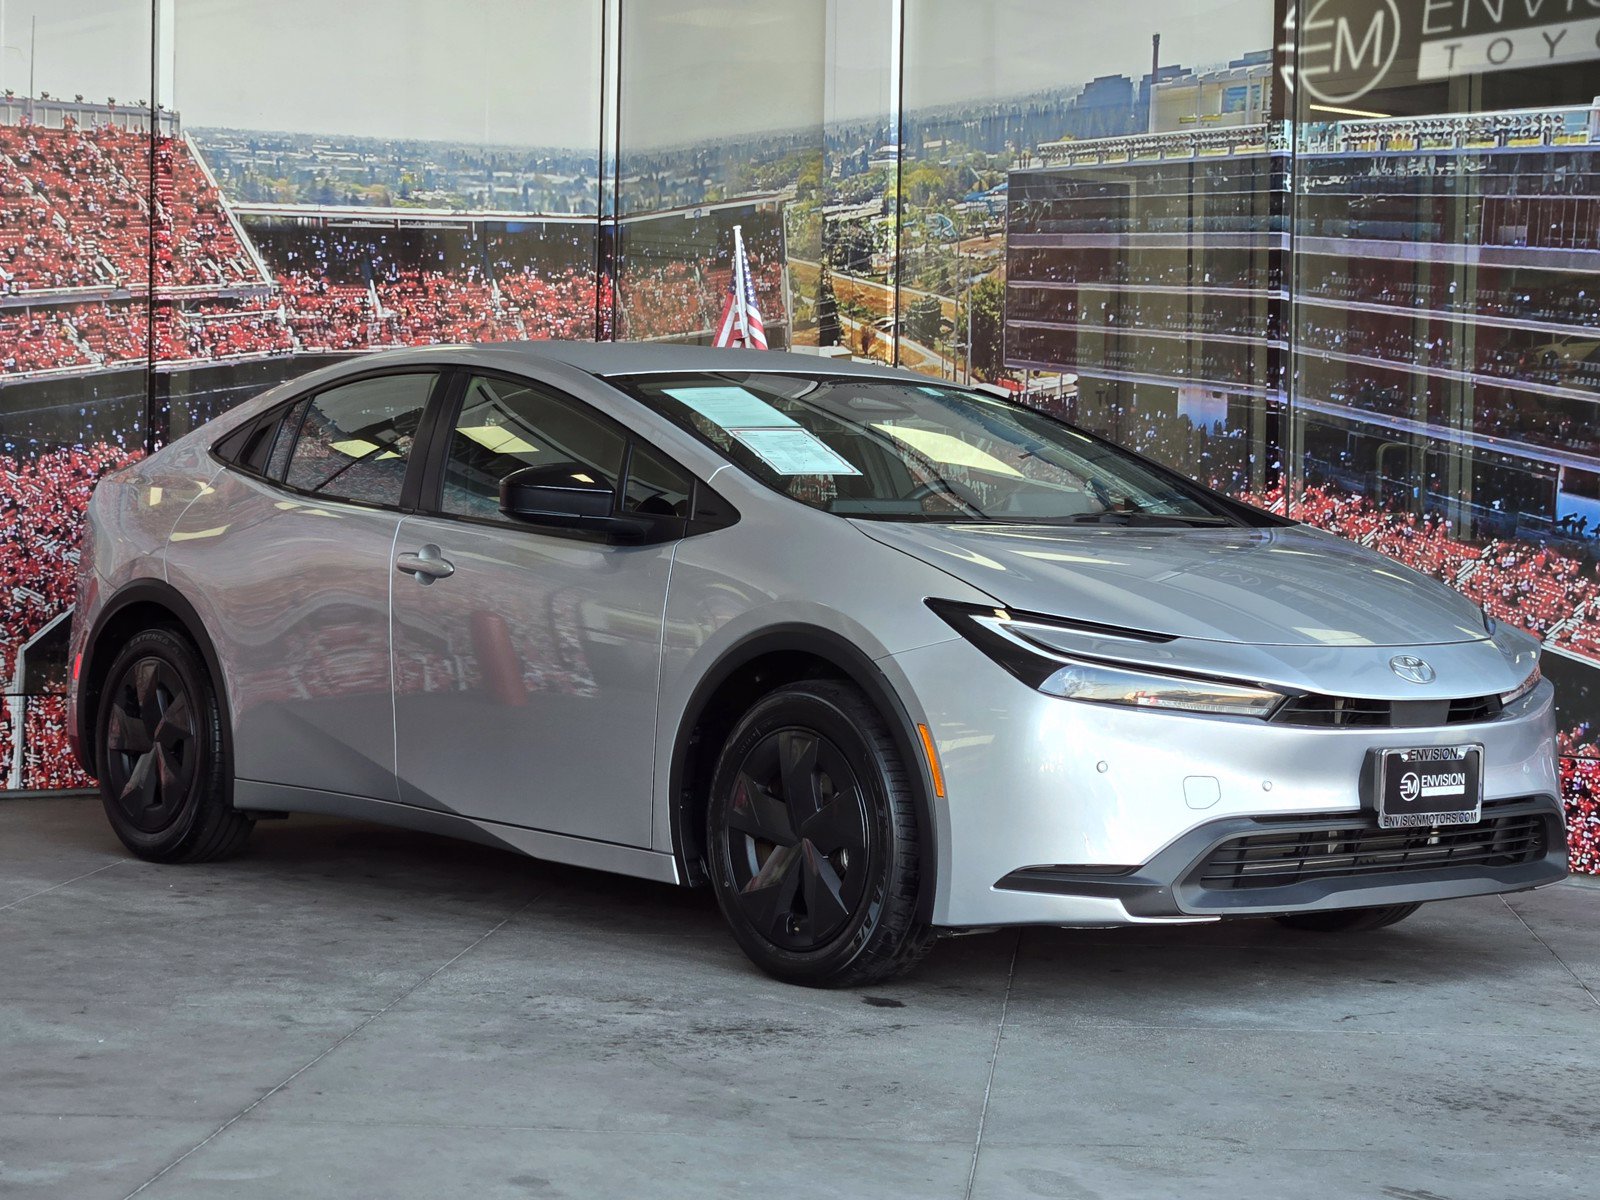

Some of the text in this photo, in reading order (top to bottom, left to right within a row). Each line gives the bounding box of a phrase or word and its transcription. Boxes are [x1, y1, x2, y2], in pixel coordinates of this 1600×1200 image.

[1443, 28, 1600, 71] TOY
[1410, 748, 1459, 761] ENVISION
[1421, 773, 1466, 787] ENVISION
